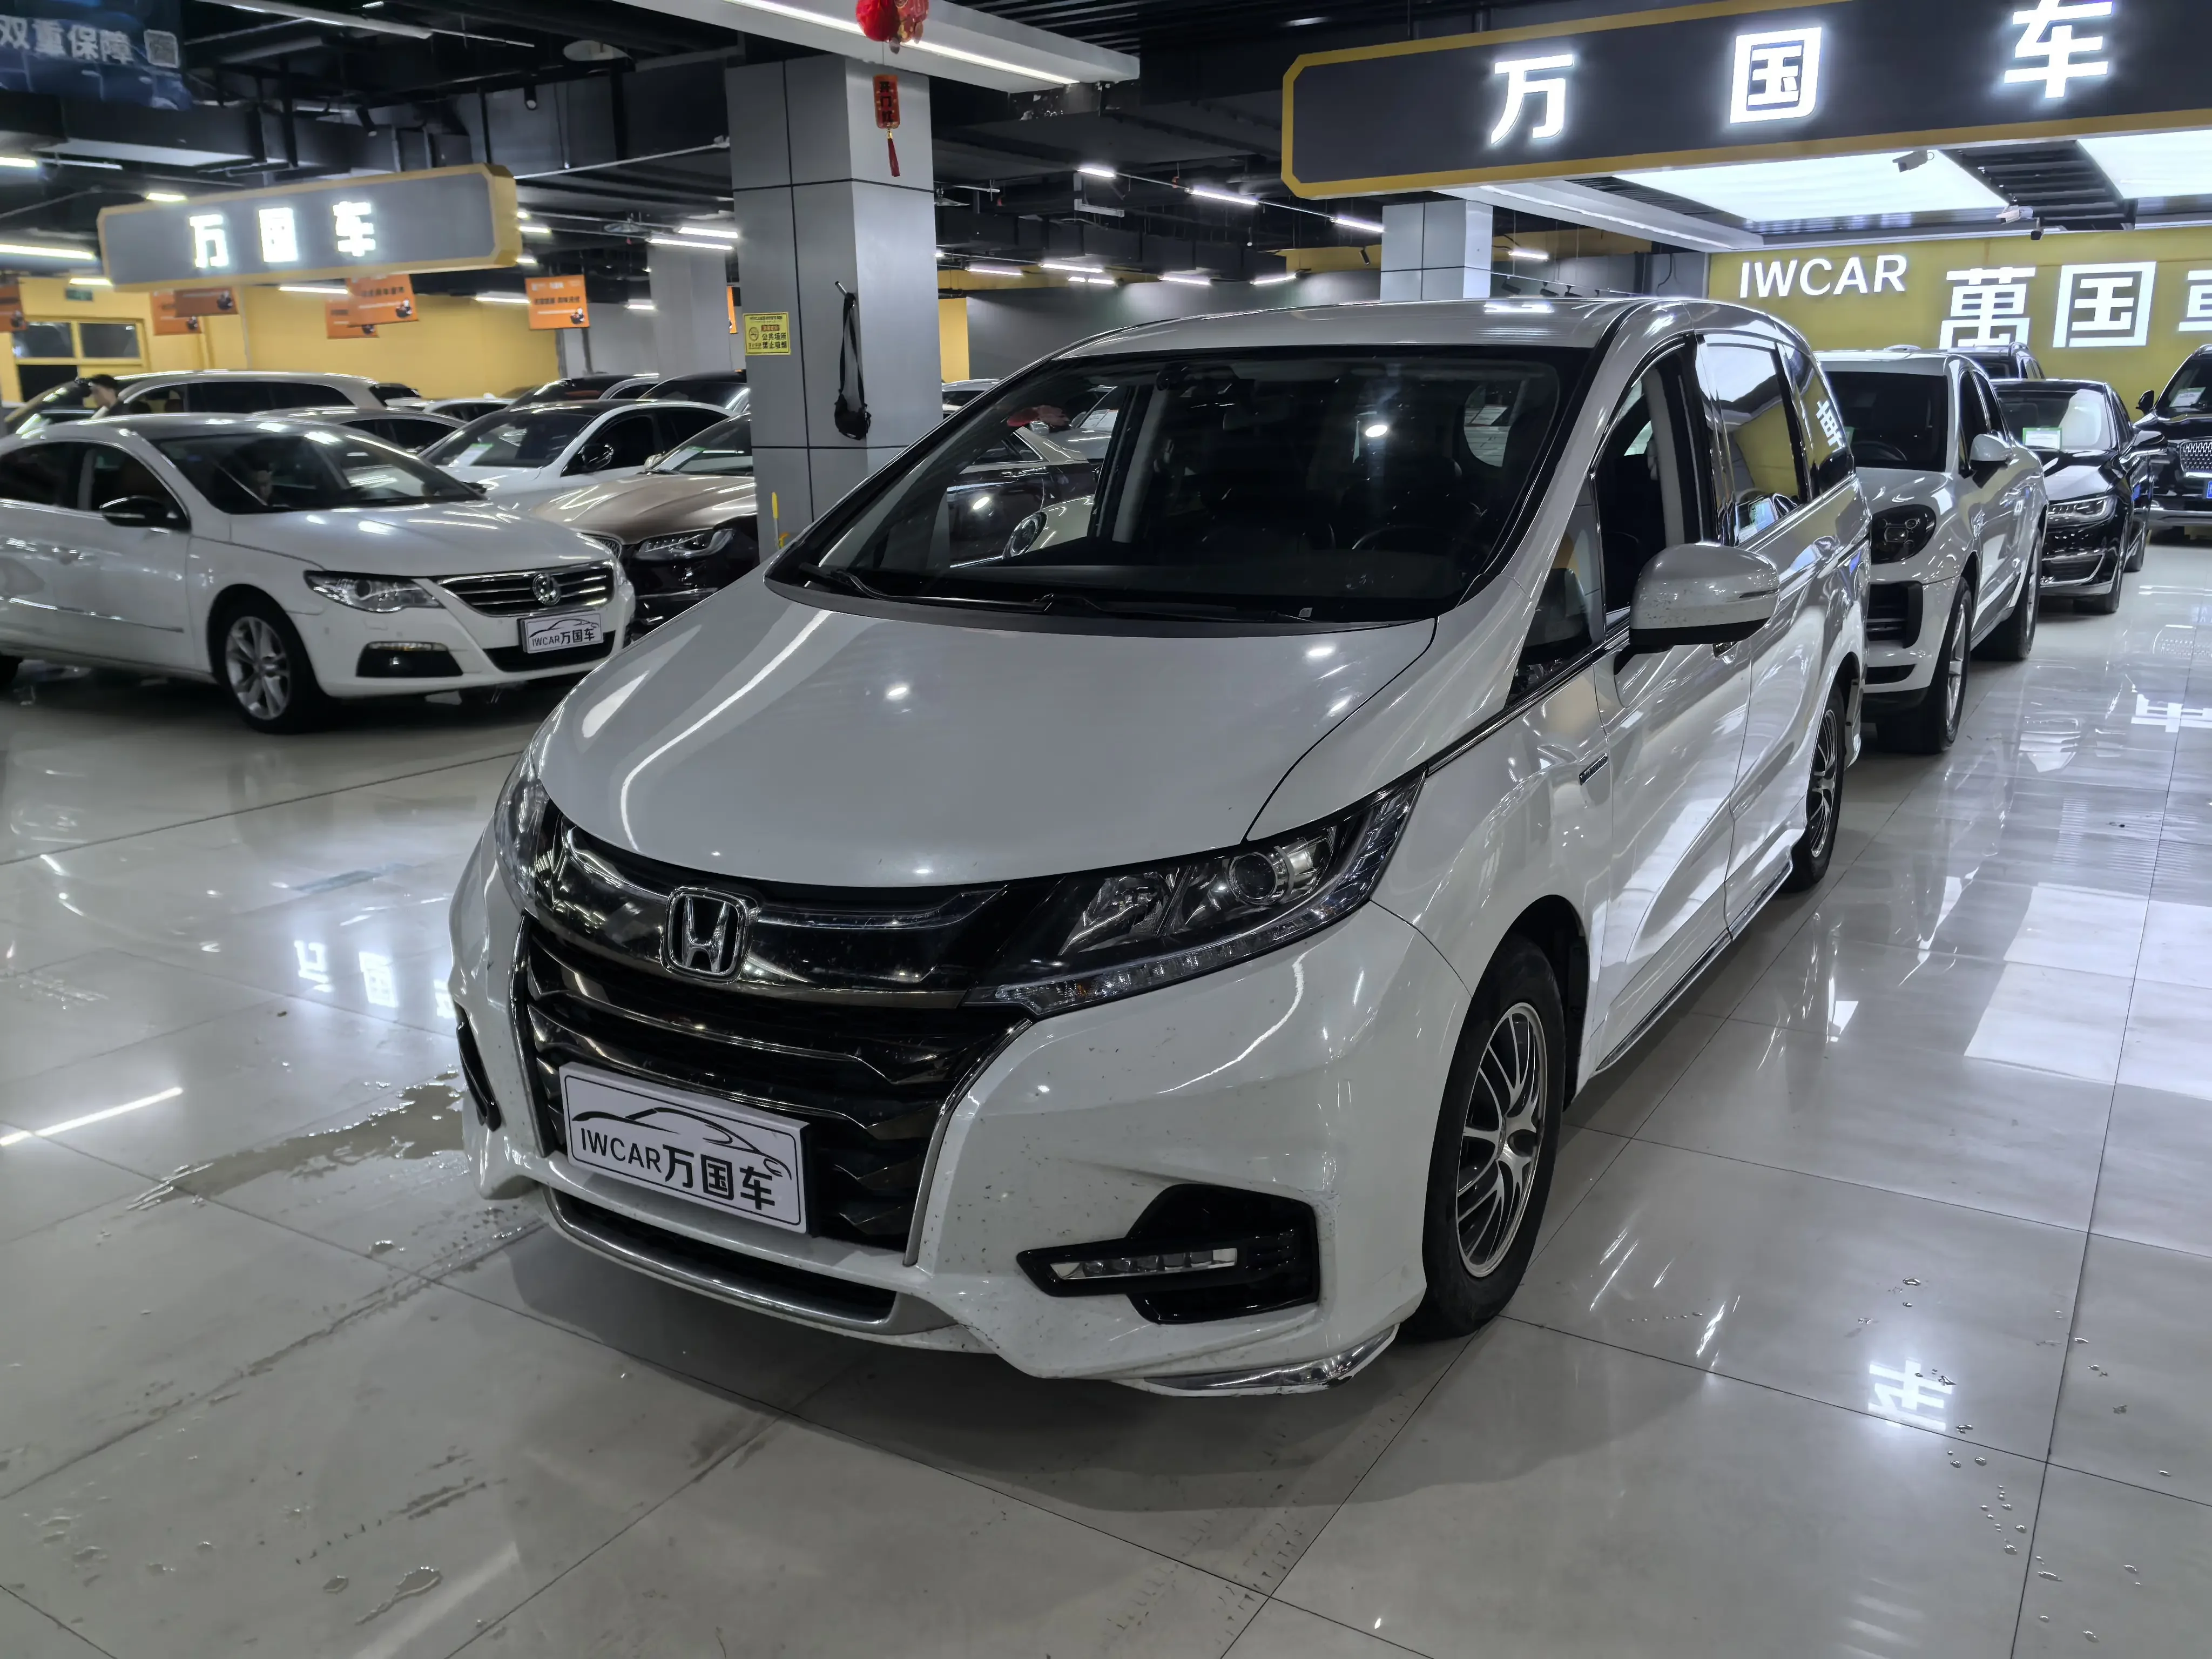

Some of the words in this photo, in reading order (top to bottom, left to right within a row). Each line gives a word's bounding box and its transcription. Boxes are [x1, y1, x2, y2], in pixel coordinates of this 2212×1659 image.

[1489, 0, 2114, 146] 万国车
[1739, 254, 1908, 299] IWCAR
